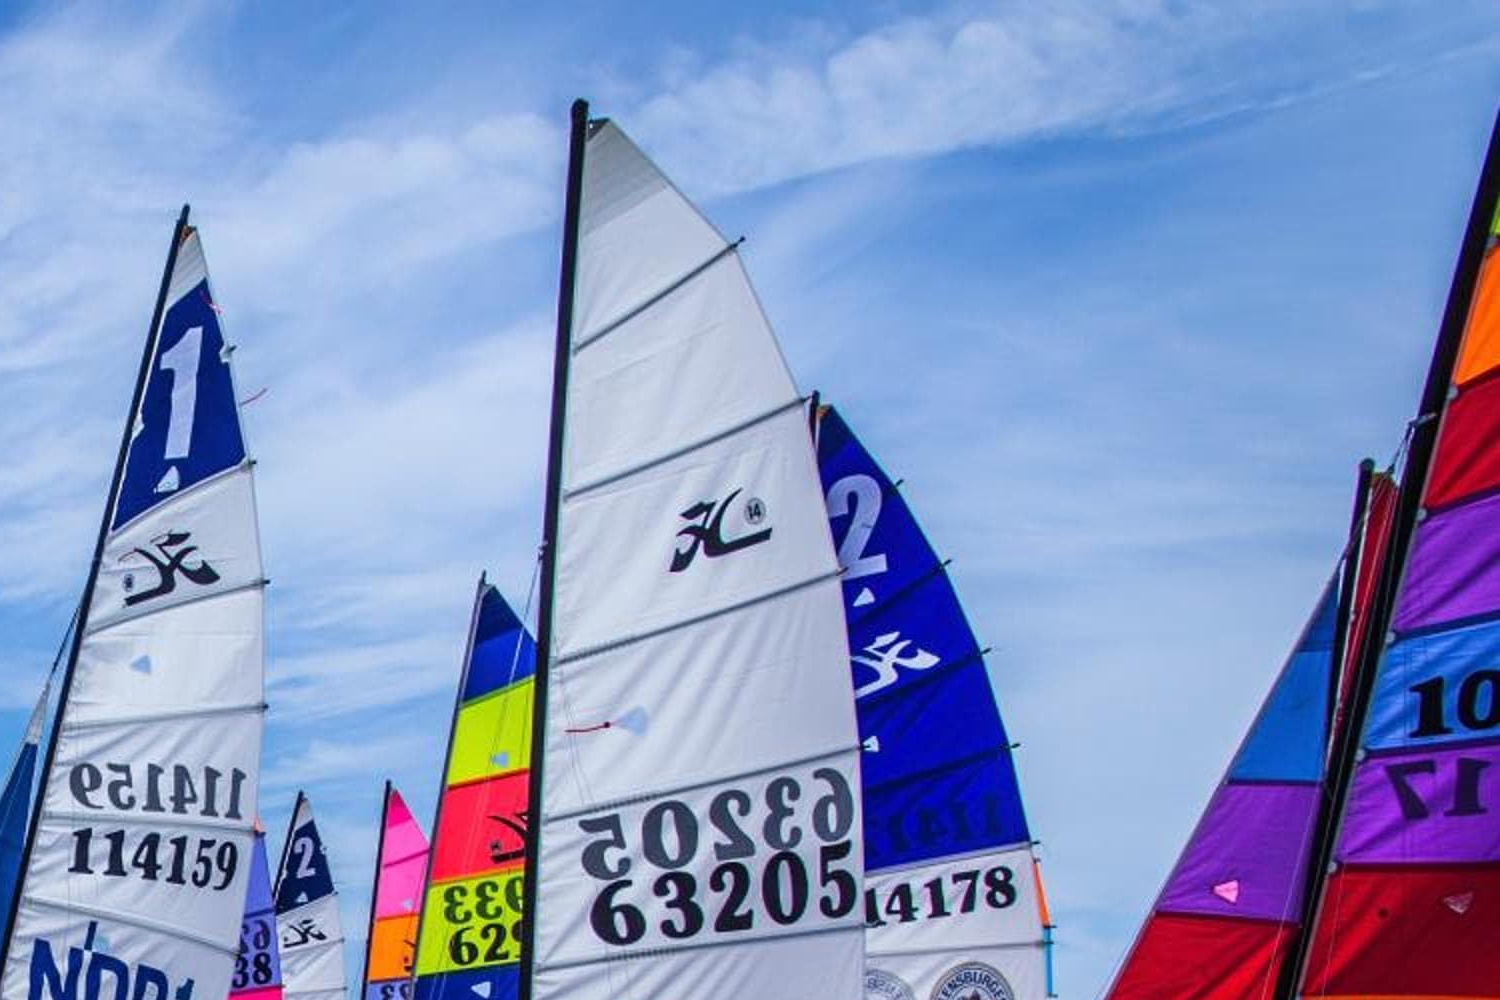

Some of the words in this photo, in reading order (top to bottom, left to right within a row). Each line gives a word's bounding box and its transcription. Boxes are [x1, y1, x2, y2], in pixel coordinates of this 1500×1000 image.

[160, 326, 203, 461] 1
[829, 474, 888, 581] 2
[68, 827, 238, 891] 114159
[295, 836, 316, 878] 2
[590, 840, 858, 945] 63205
